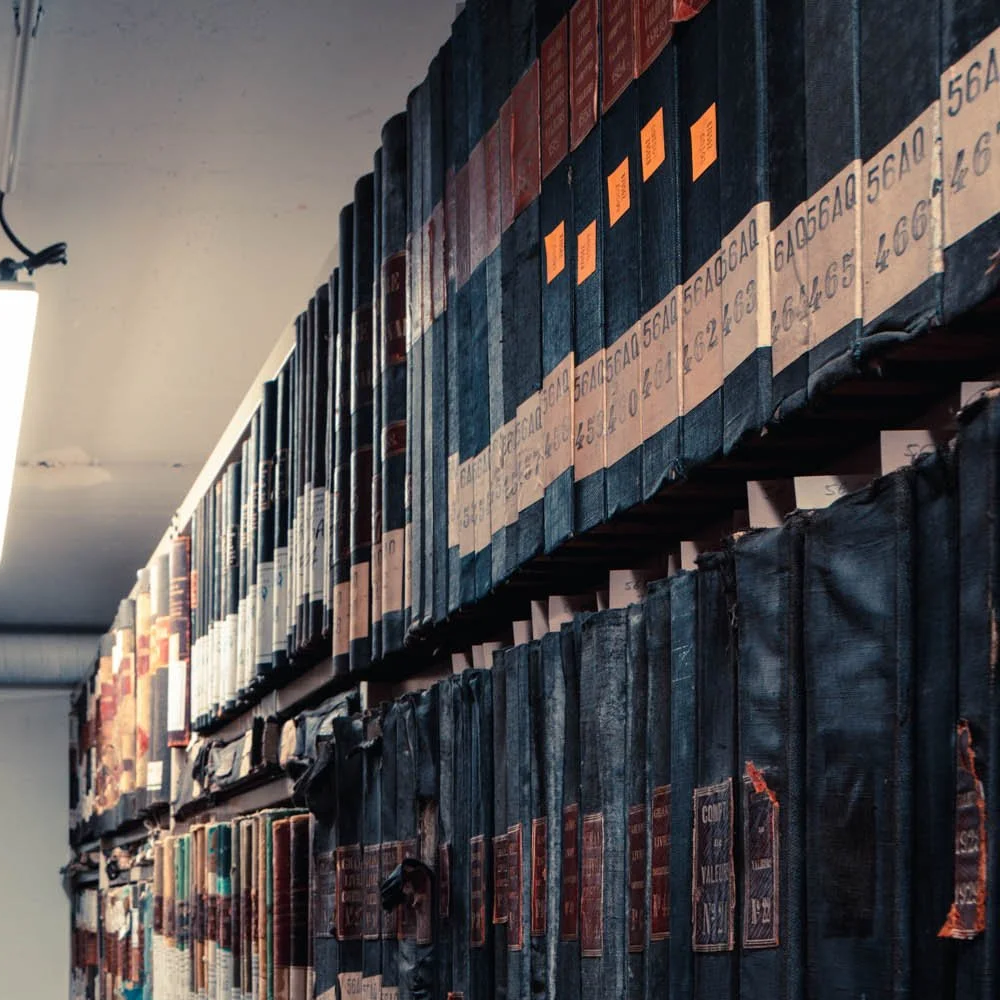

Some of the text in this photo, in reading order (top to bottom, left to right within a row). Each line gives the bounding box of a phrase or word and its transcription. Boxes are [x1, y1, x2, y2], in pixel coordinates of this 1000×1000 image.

[867, 126, 925, 205] 56AQ
[805, 173, 857, 242] 56AQ
[875, 198, 927, 271] 466
[684, 254, 725, 317] 56AQ
[721, 279, 757, 337] 463
[808, 248, 855, 314] 465
[643, 295, 678, 349] 56AQ
